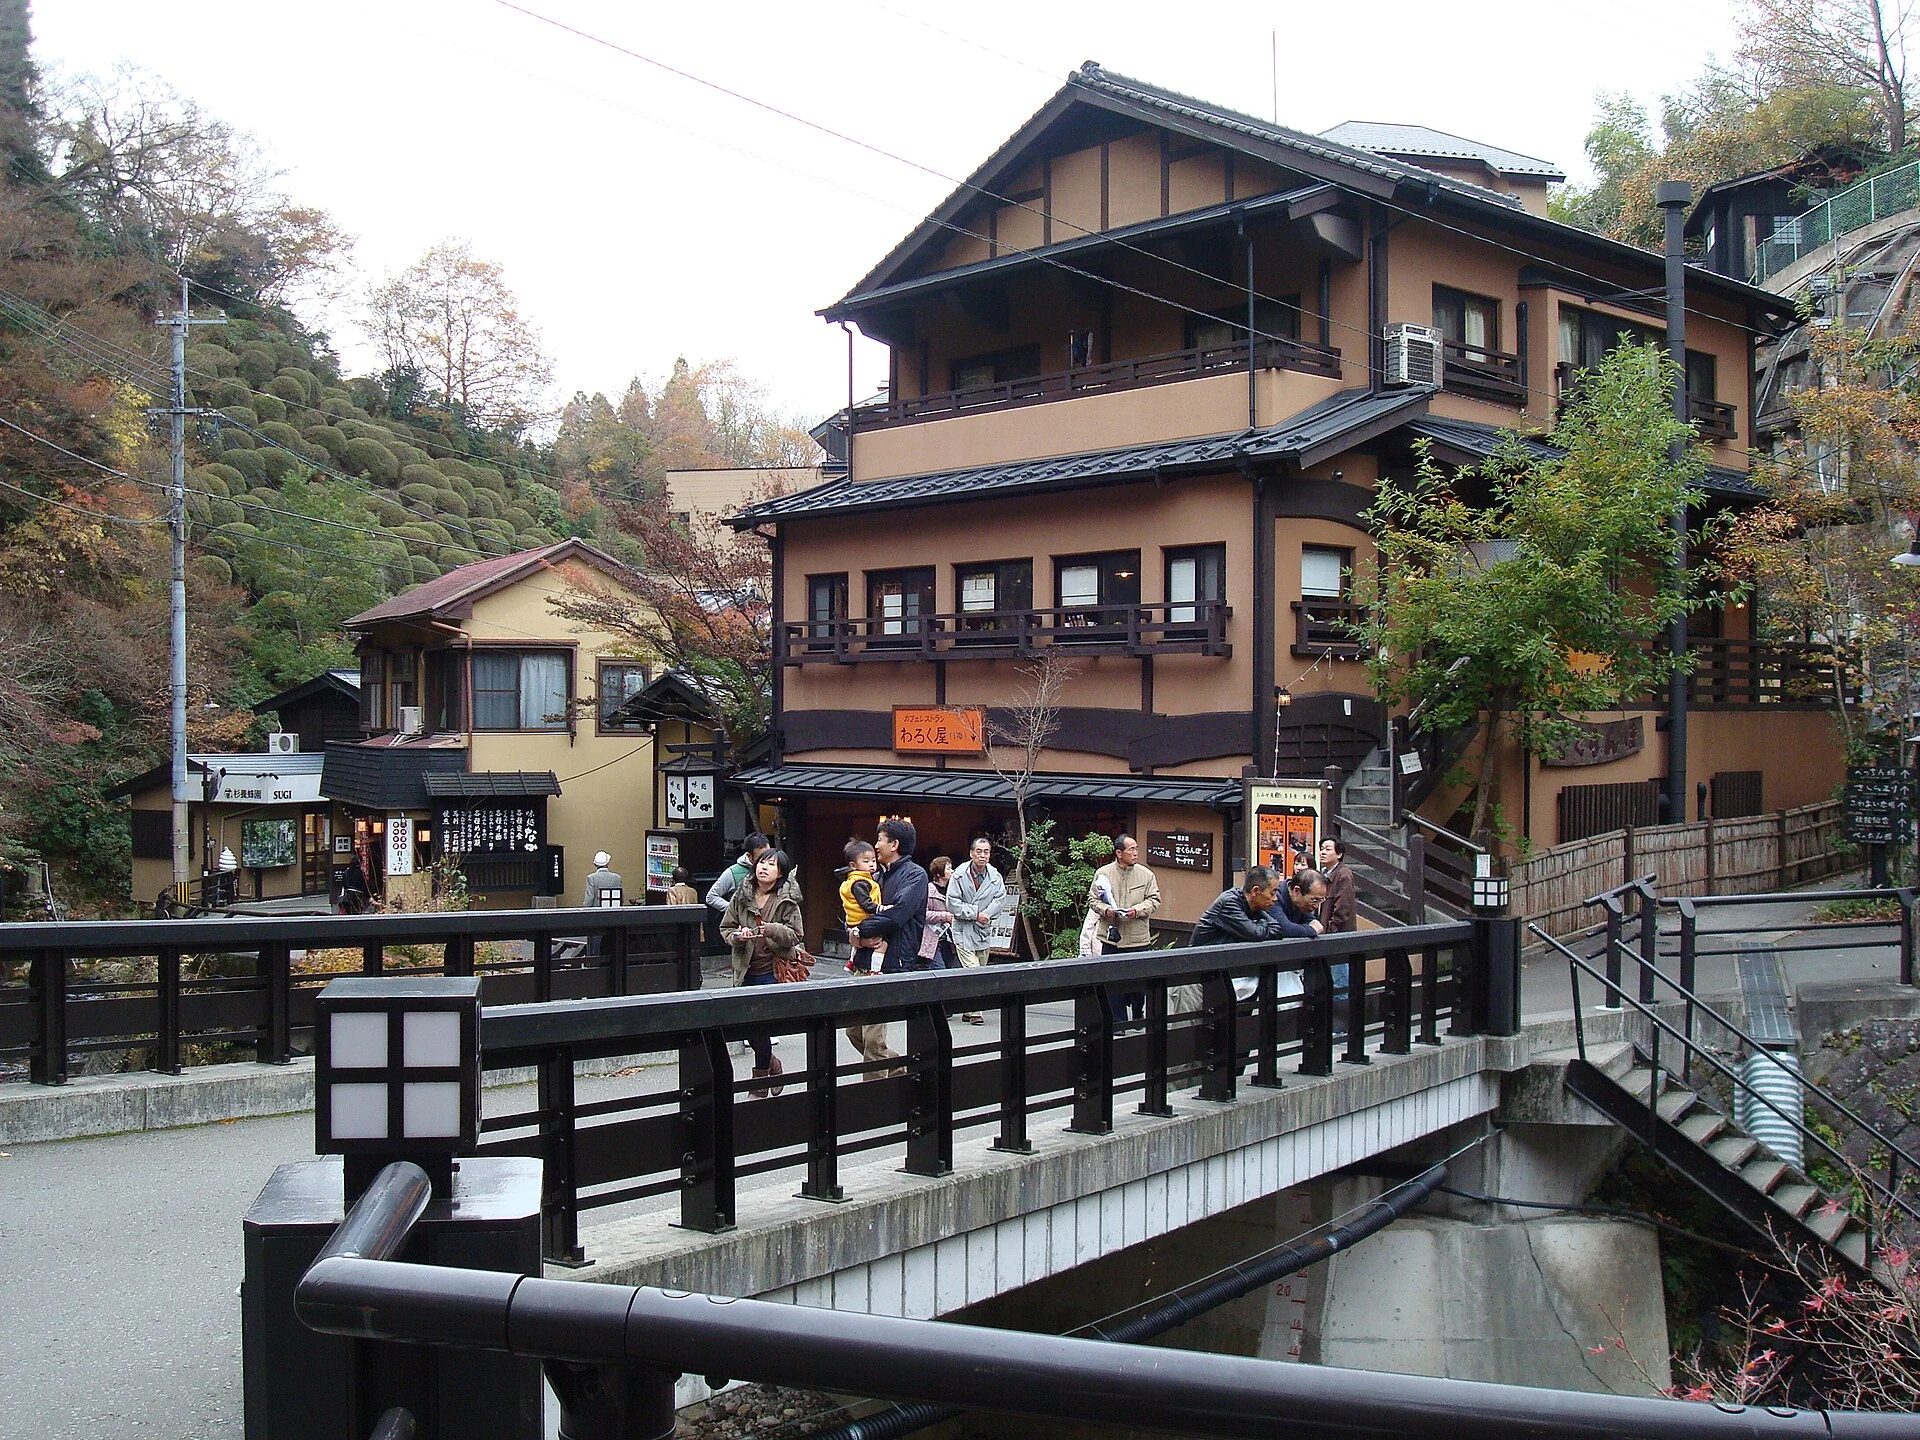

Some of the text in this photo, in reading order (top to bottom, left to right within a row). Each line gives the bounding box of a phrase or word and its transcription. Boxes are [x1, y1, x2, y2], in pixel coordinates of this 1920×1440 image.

[903, 715, 945, 723] カフェレストラン
[900, 727, 949, 745] わろく屋
[273, 790, 293, 800] SUGI
[689, 792, 712, 812] なか
[524, 827, 538, 852] なか
[1277, 1283, 1291, 1296] 20
